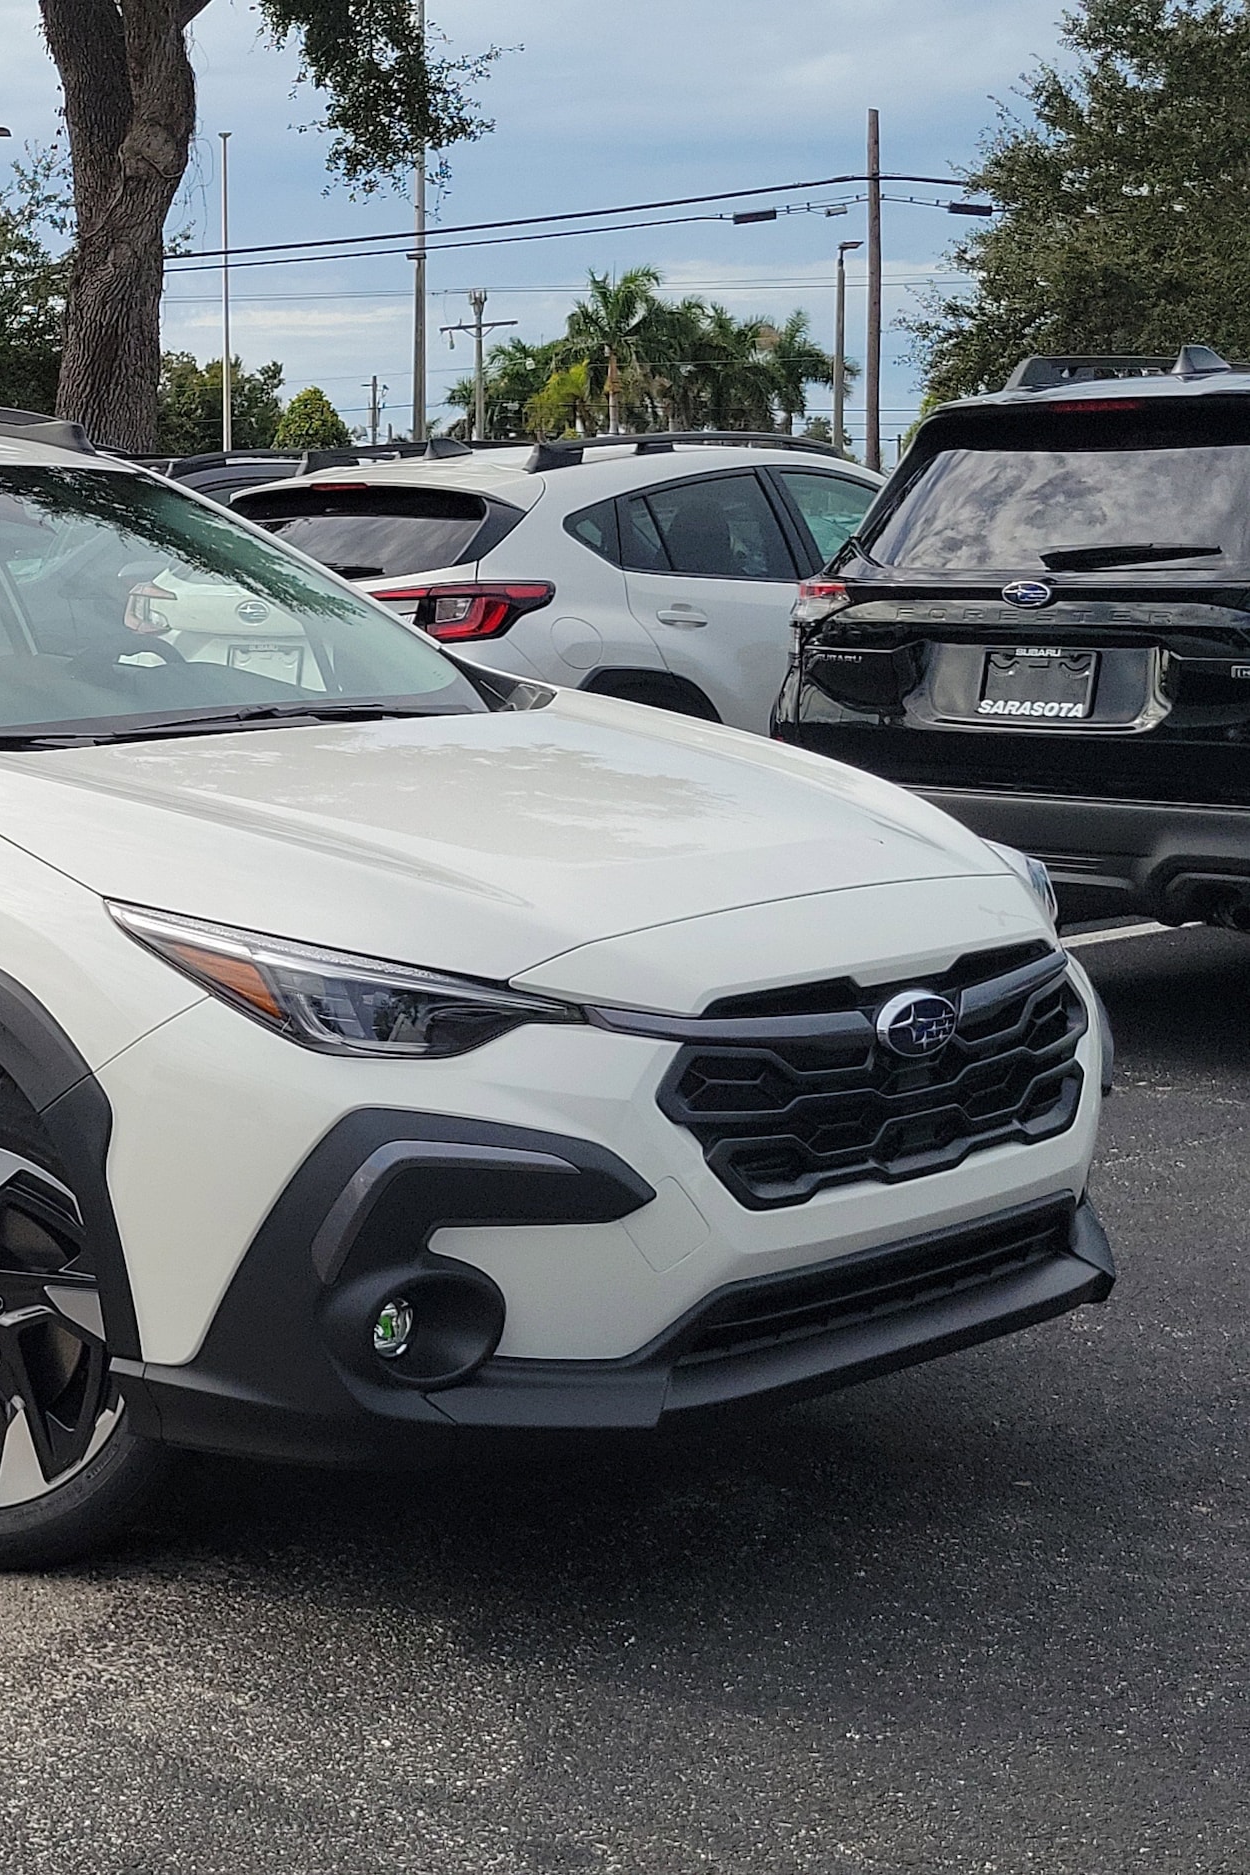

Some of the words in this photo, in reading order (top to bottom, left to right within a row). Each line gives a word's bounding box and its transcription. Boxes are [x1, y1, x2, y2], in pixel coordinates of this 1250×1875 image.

[894, 606, 1174, 625] FORESTER
[1015, 648, 1062, 657] SUBARU
[977, 699, 1084, 718] SARASOTA
